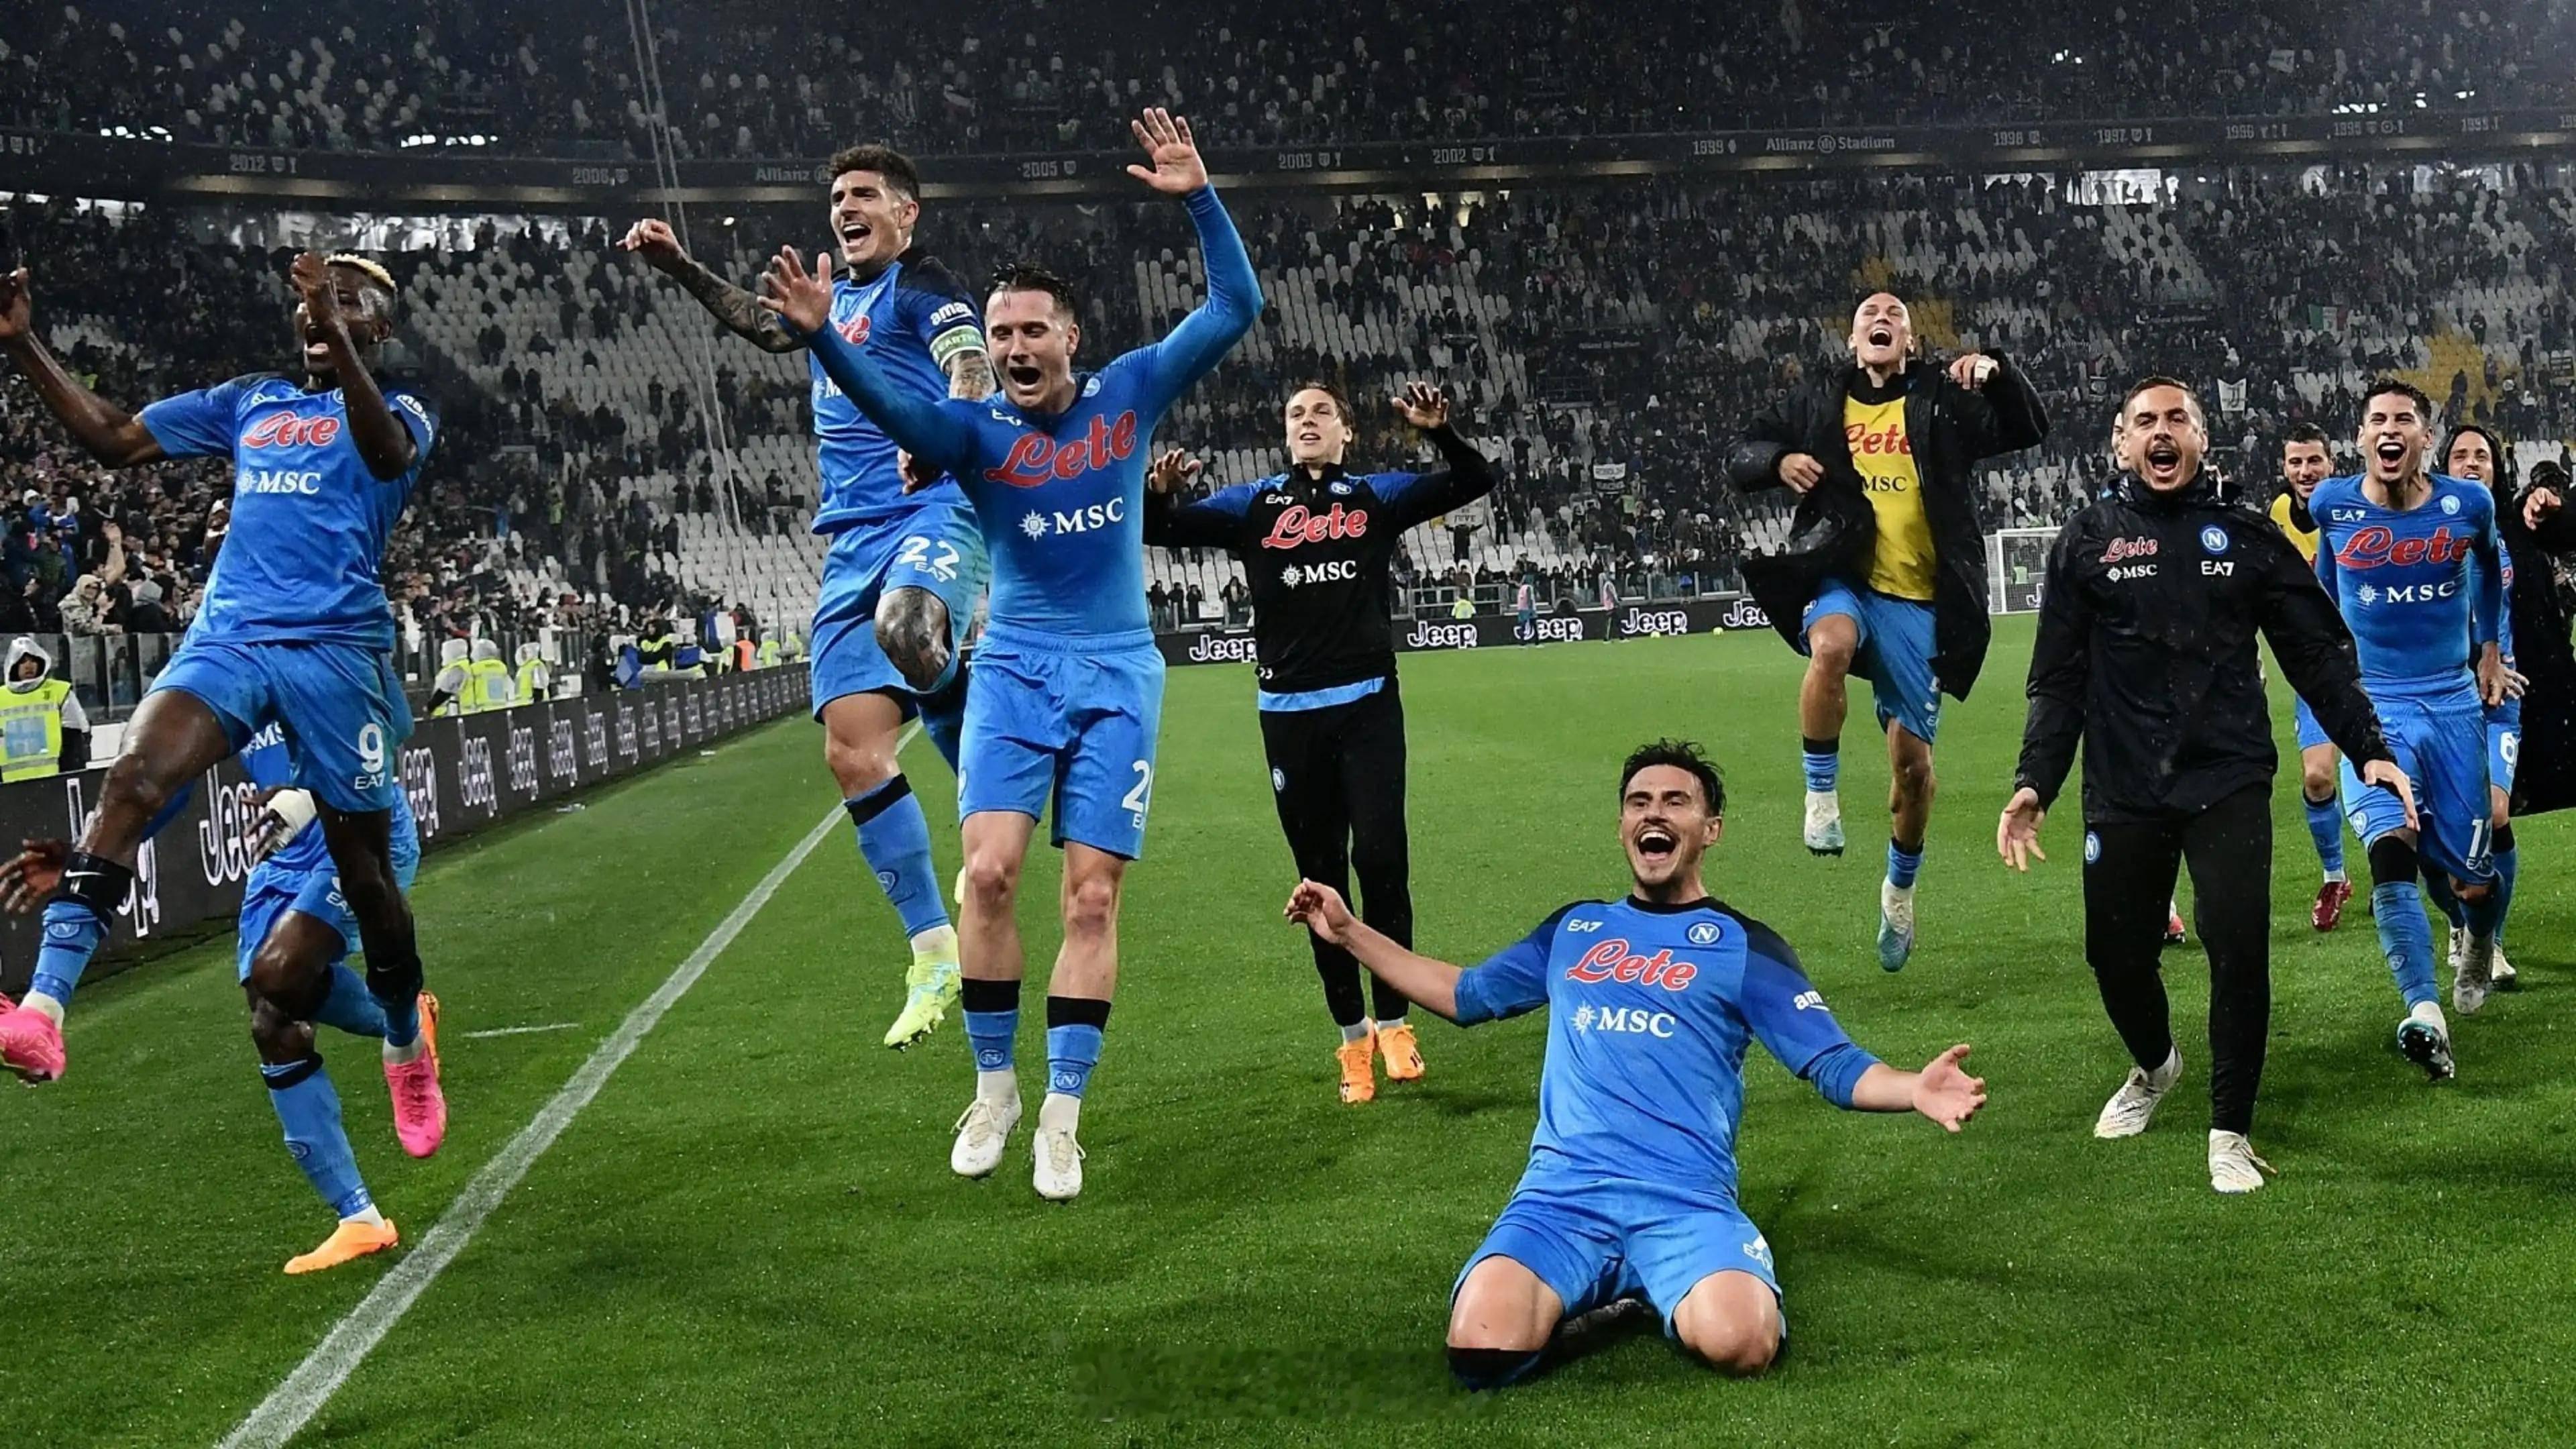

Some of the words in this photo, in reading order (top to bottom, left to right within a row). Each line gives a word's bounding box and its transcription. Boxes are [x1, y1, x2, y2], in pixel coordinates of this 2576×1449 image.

[1432, 148, 1467, 164] 2002
[1766, 138, 1815, 151] Allianz
[1838, 136, 1895, 150] Stadium
[229, 154, 266, 172] 2012
[755, 166, 810, 182] Allianz
[1022, 161, 1059, 178] 2005
[1279, 153, 1313, 169] 2003
[930, 302, 973, 325] ama
[983, 409, 1137, 488] Lete
[256, 471, 321, 495] MSC
[1862, 475, 1907, 492] MSC
[1265, 494, 1294, 505] EA7
[1052, 496, 1124, 535] MSC
[1261, 502, 1368, 549] Lete
[2331, 508, 2366, 522] EA7
[899, 536, 960, 580] 22
[2098, 536, 2159, 564] Lete
[2335, 526, 2473, 570] Lete
[1303, 559, 1357, 584] MSC
[2123, 564, 2158, 580] MSC
[2201, 560, 2235, 577] EA7
[2385, 580, 2456, 604] MSC
[1621, 608, 1688, 636] Jeep
[1723, 601, 1771, 627] Jee
[1408, 621, 1478, 649] Jeep
[1188, 634, 1258, 663] Jeep
[254, 720, 286, 751] MS
[358, 722, 384, 773] 9
[458, 717, 498, 818] Jeep
[354, 772, 386, 790] EA7
[397, 743, 440, 838] eep
[1122, 759, 1152, 814] 2
[199, 763, 268, 887] Jee
[1567, 918, 1604, 934] EA7
[1566, 938, 1698, 991] Lete
[1597, 1006, 1676, 1038] MSC
